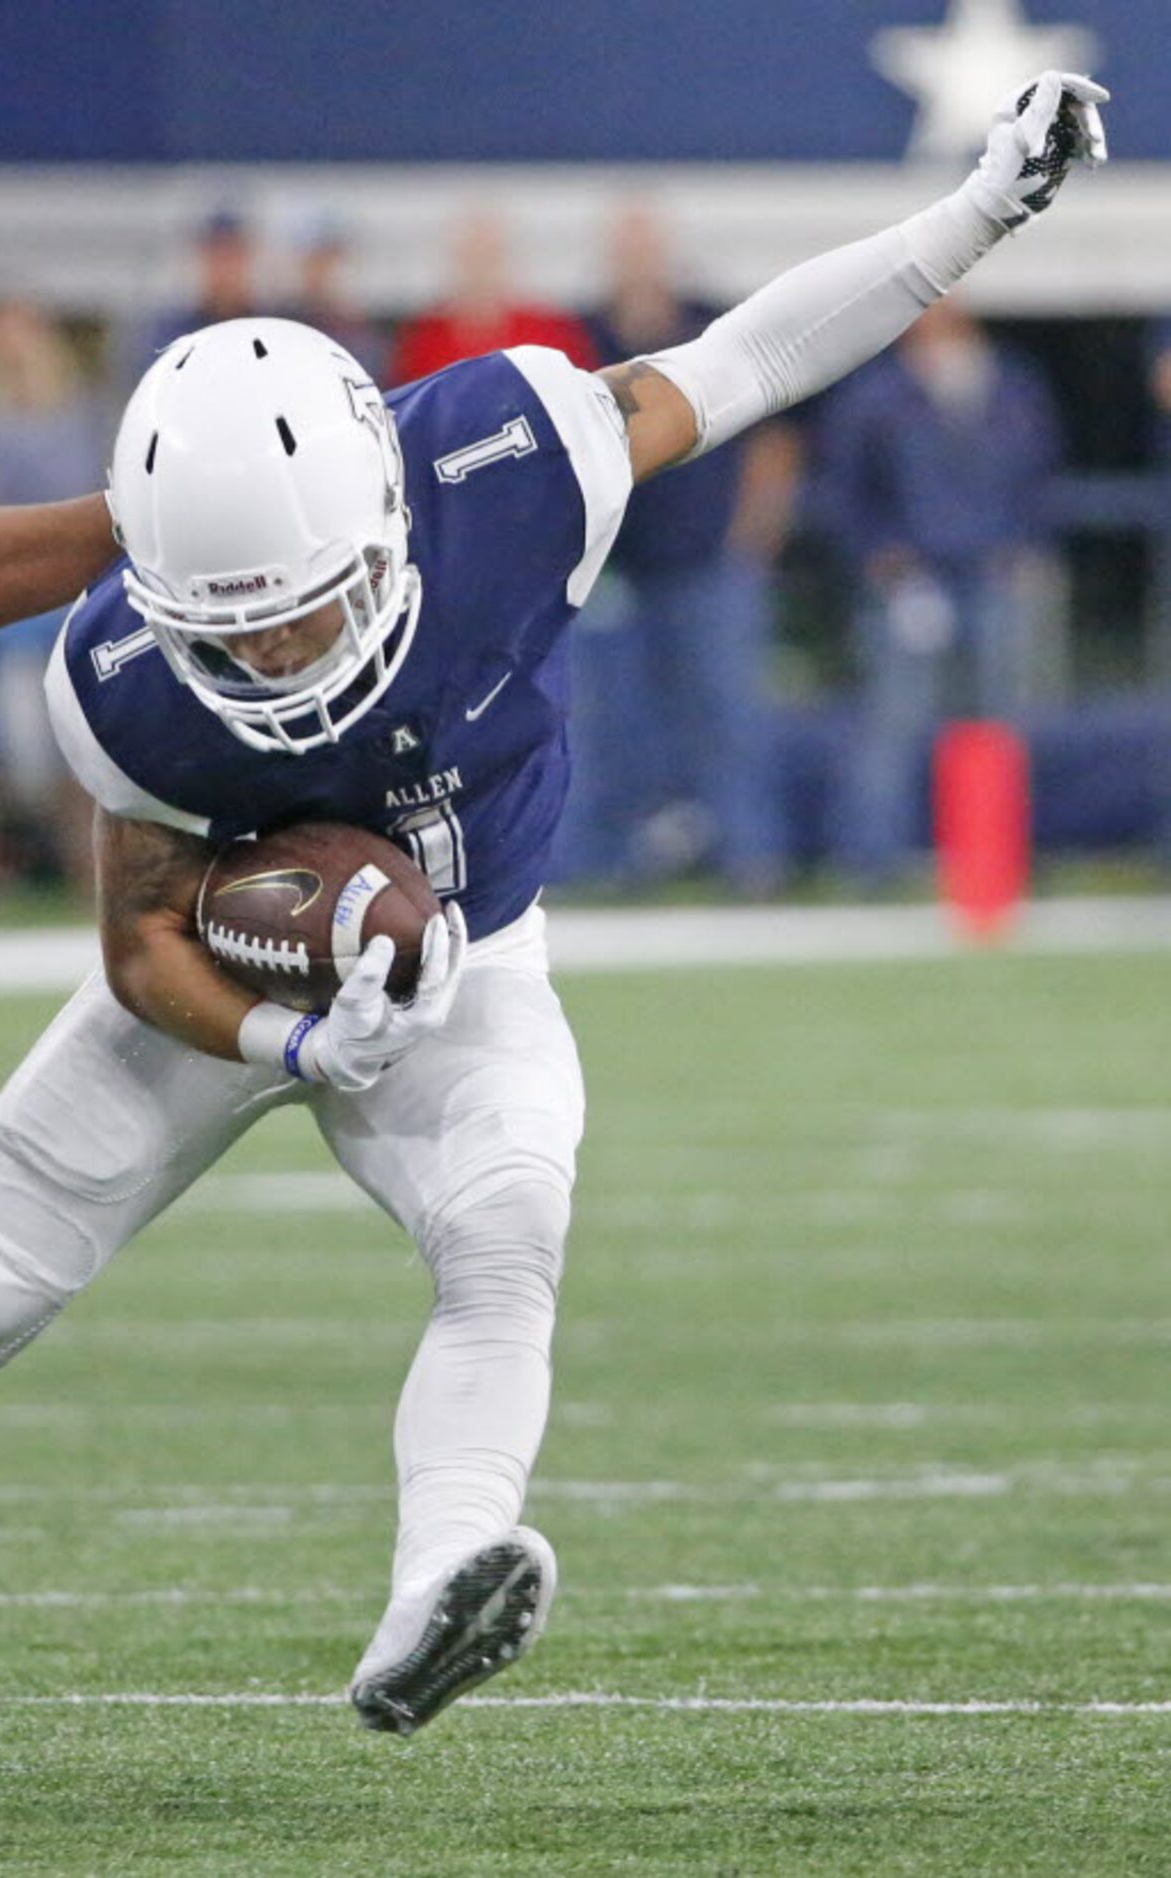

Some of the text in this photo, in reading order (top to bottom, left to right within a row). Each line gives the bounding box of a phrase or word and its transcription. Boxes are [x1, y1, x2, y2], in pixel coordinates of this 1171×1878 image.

[433, 414, 538, 484] 1
[393, 725, 418, 753] A
[385, 766, 464, 809] ALLEN
